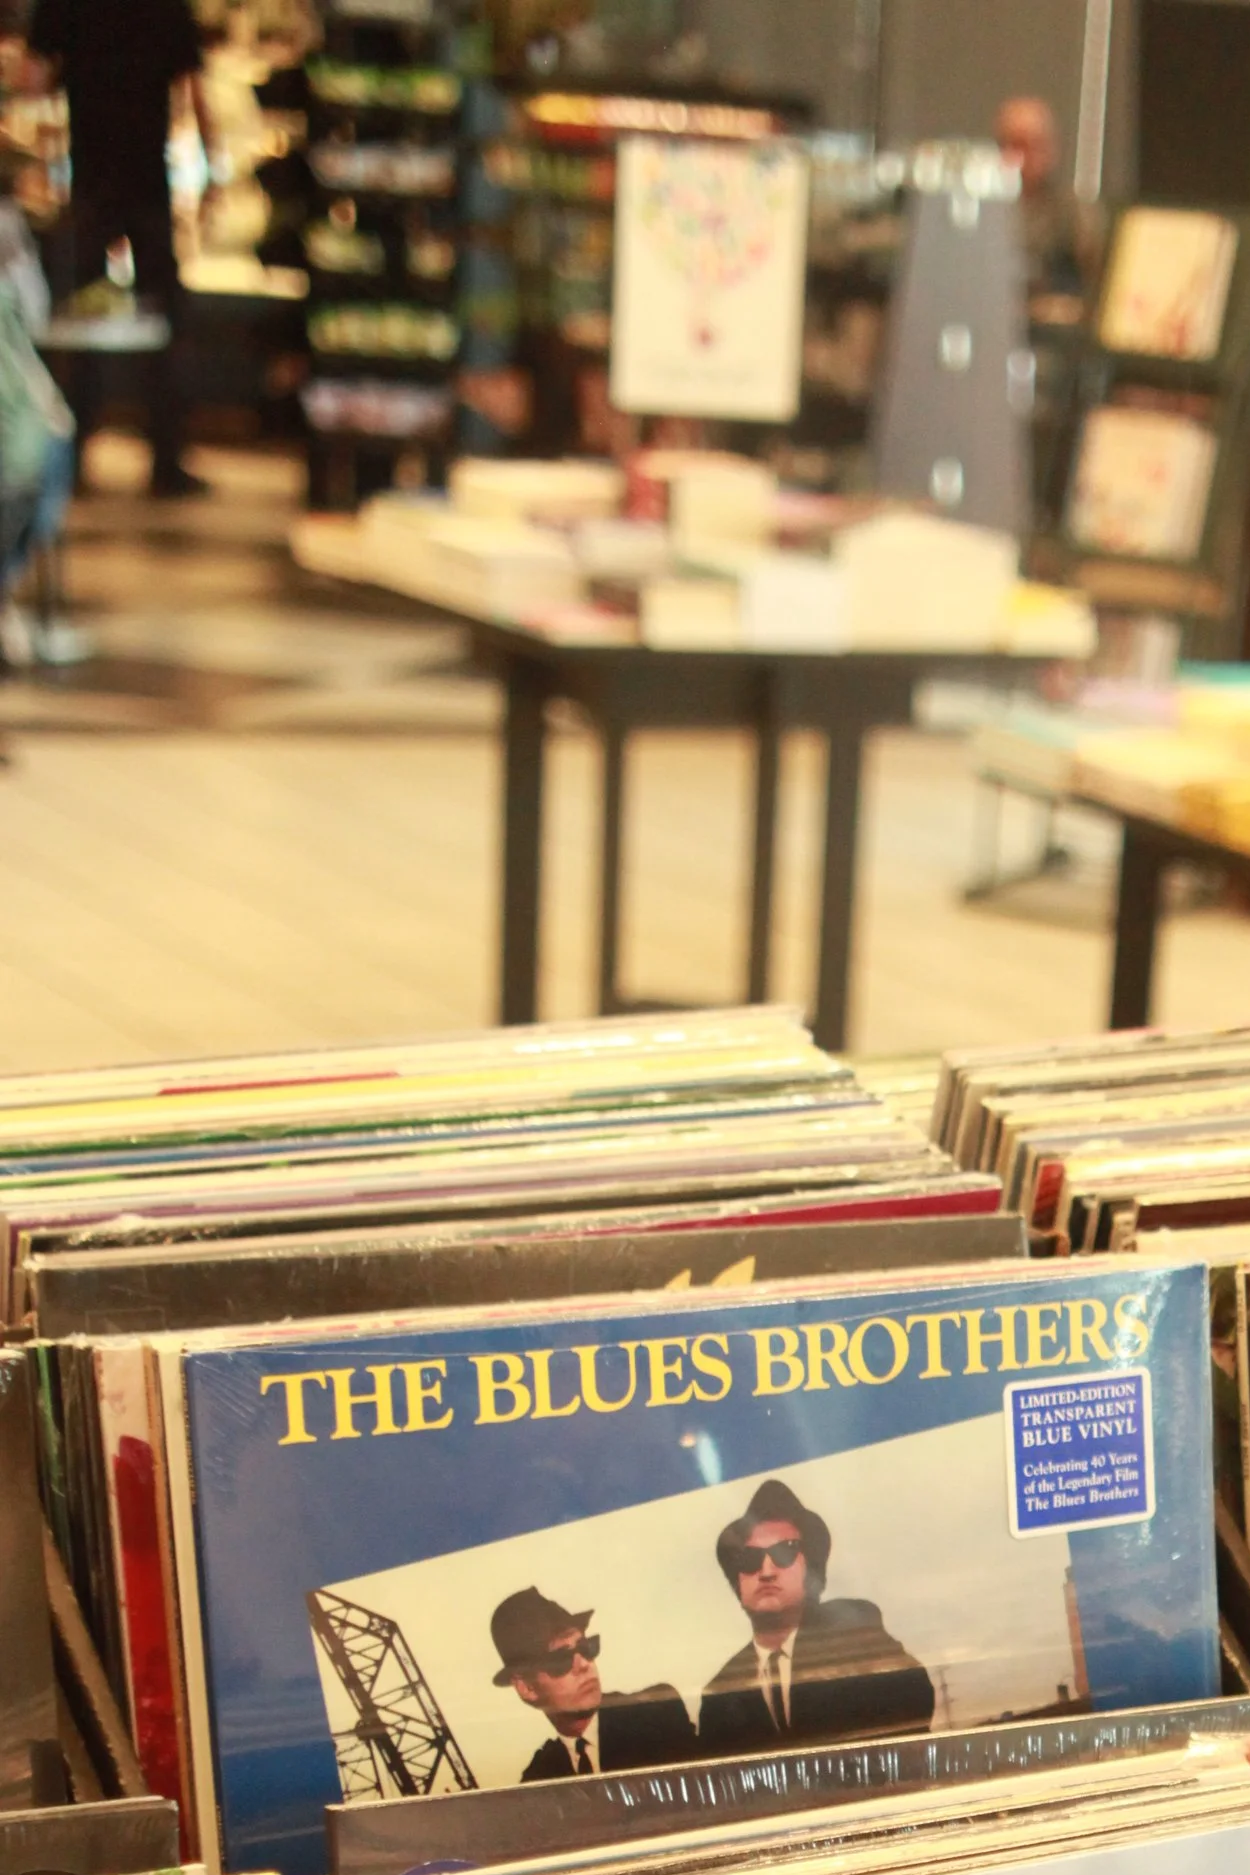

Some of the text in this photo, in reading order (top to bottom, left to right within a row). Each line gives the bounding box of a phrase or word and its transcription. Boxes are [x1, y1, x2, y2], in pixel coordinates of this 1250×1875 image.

[261, 1360, 453, 1445] THE
[471, 1333, 734, 1427] BLUES
[750, 1294, 1151, 1396] BROTHERS
[1020, 1383, 1136, 1409] LIMITED-EDITION
[1021, 1400, 1136, 1427] TRANSPARENT
[1022, 1417, 1137, 1448] BLUE VINYL
[1023, 1452, 1138, 1478] Celebrating 40 Years
[1024, 1468, 1138, 1496] of the Legendary Film
[1025, 1487, 1139, 1512] The Blues Brothers
